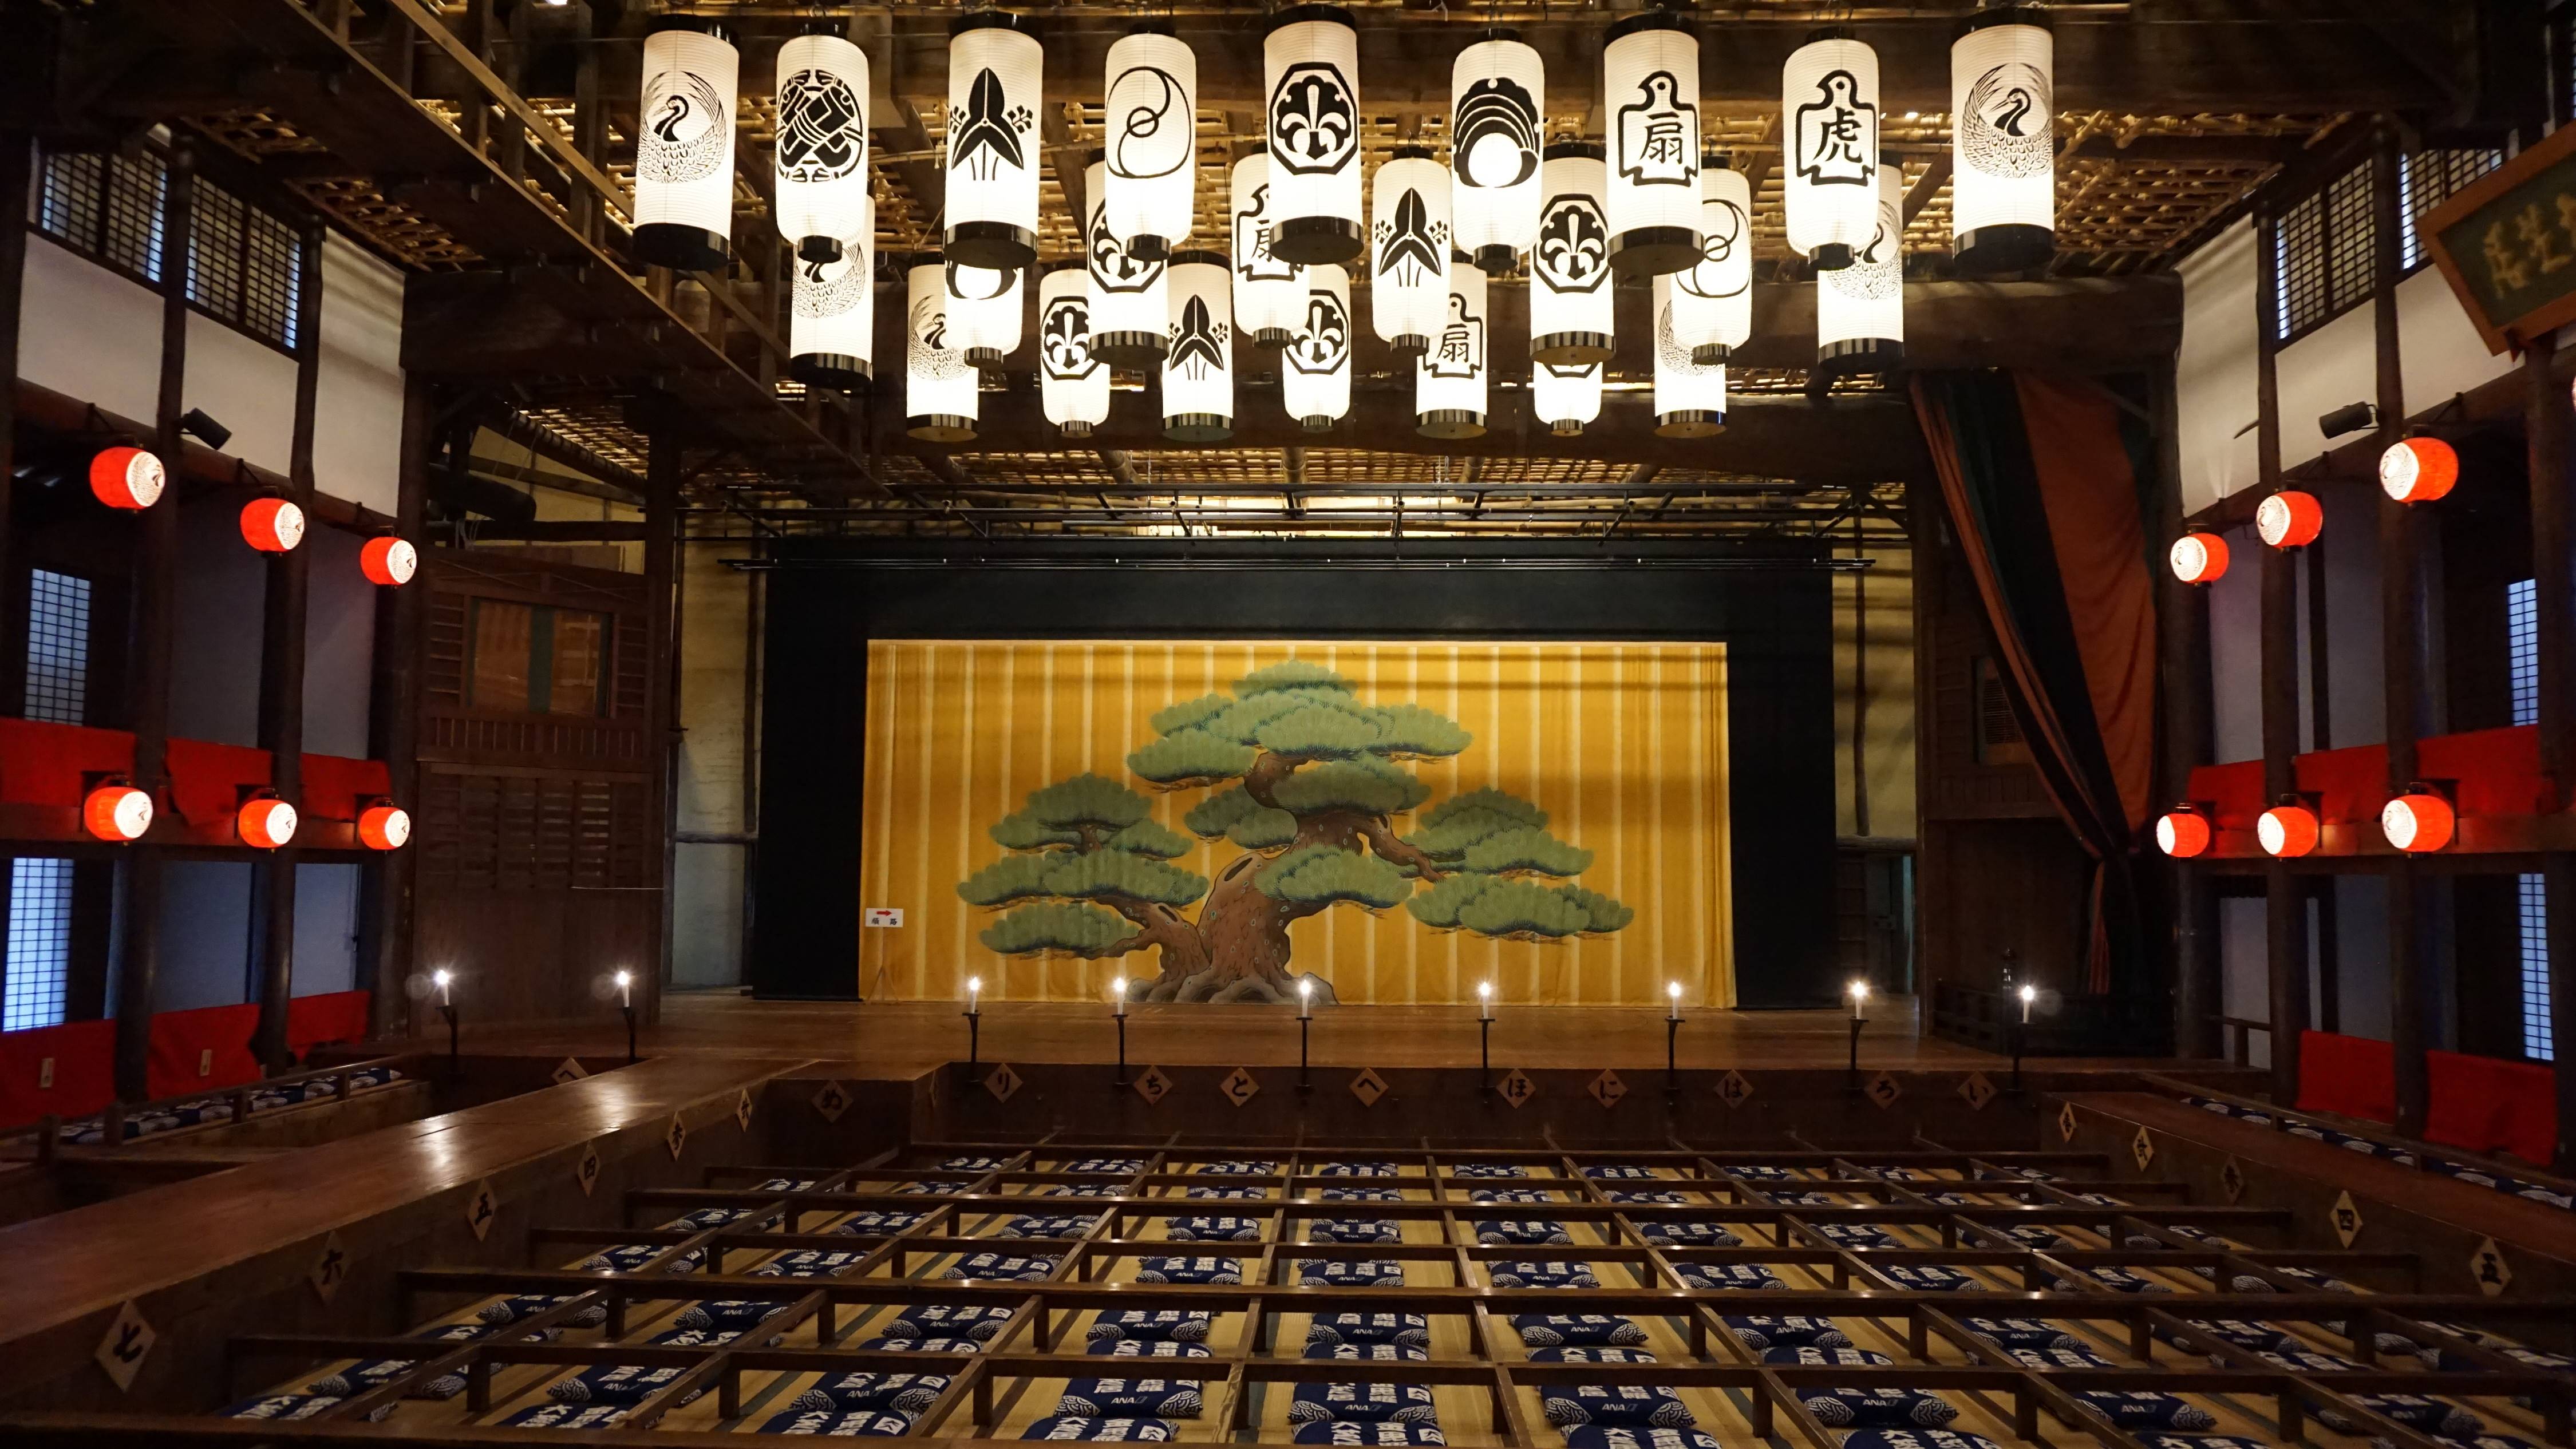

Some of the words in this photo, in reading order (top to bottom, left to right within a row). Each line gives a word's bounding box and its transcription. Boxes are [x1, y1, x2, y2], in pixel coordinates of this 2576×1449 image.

[1639, 112, 1684, 165] 扇
[1813, 106, 1863, 163] 虎
[1436, 323, 1471, 363] 扇
[997, 1072, 1010, 1094] り
[1145, 1074, 1164, 1095] ち
[1232, 1076, 1249, 1096] と
[1357, 1078, 1380, 1094] へ
[1506, 1078, 1527, 1098] ほ
[1598, 1079, 1619, 1100] に
[1722, 1078, 1743, 1099] は
[1875, 1079, 1895, 1100] ろ
[1967, 1080, 1988, 1103] い
[583, 1155, 596, 1181] 四
[2337, 1209, 2354, 1232] 四
[321, 1248, 342, 1285] 六
[2480, 1252, 2503, 1285] 五
[2121, 1405, 2146, 1413] ANA
